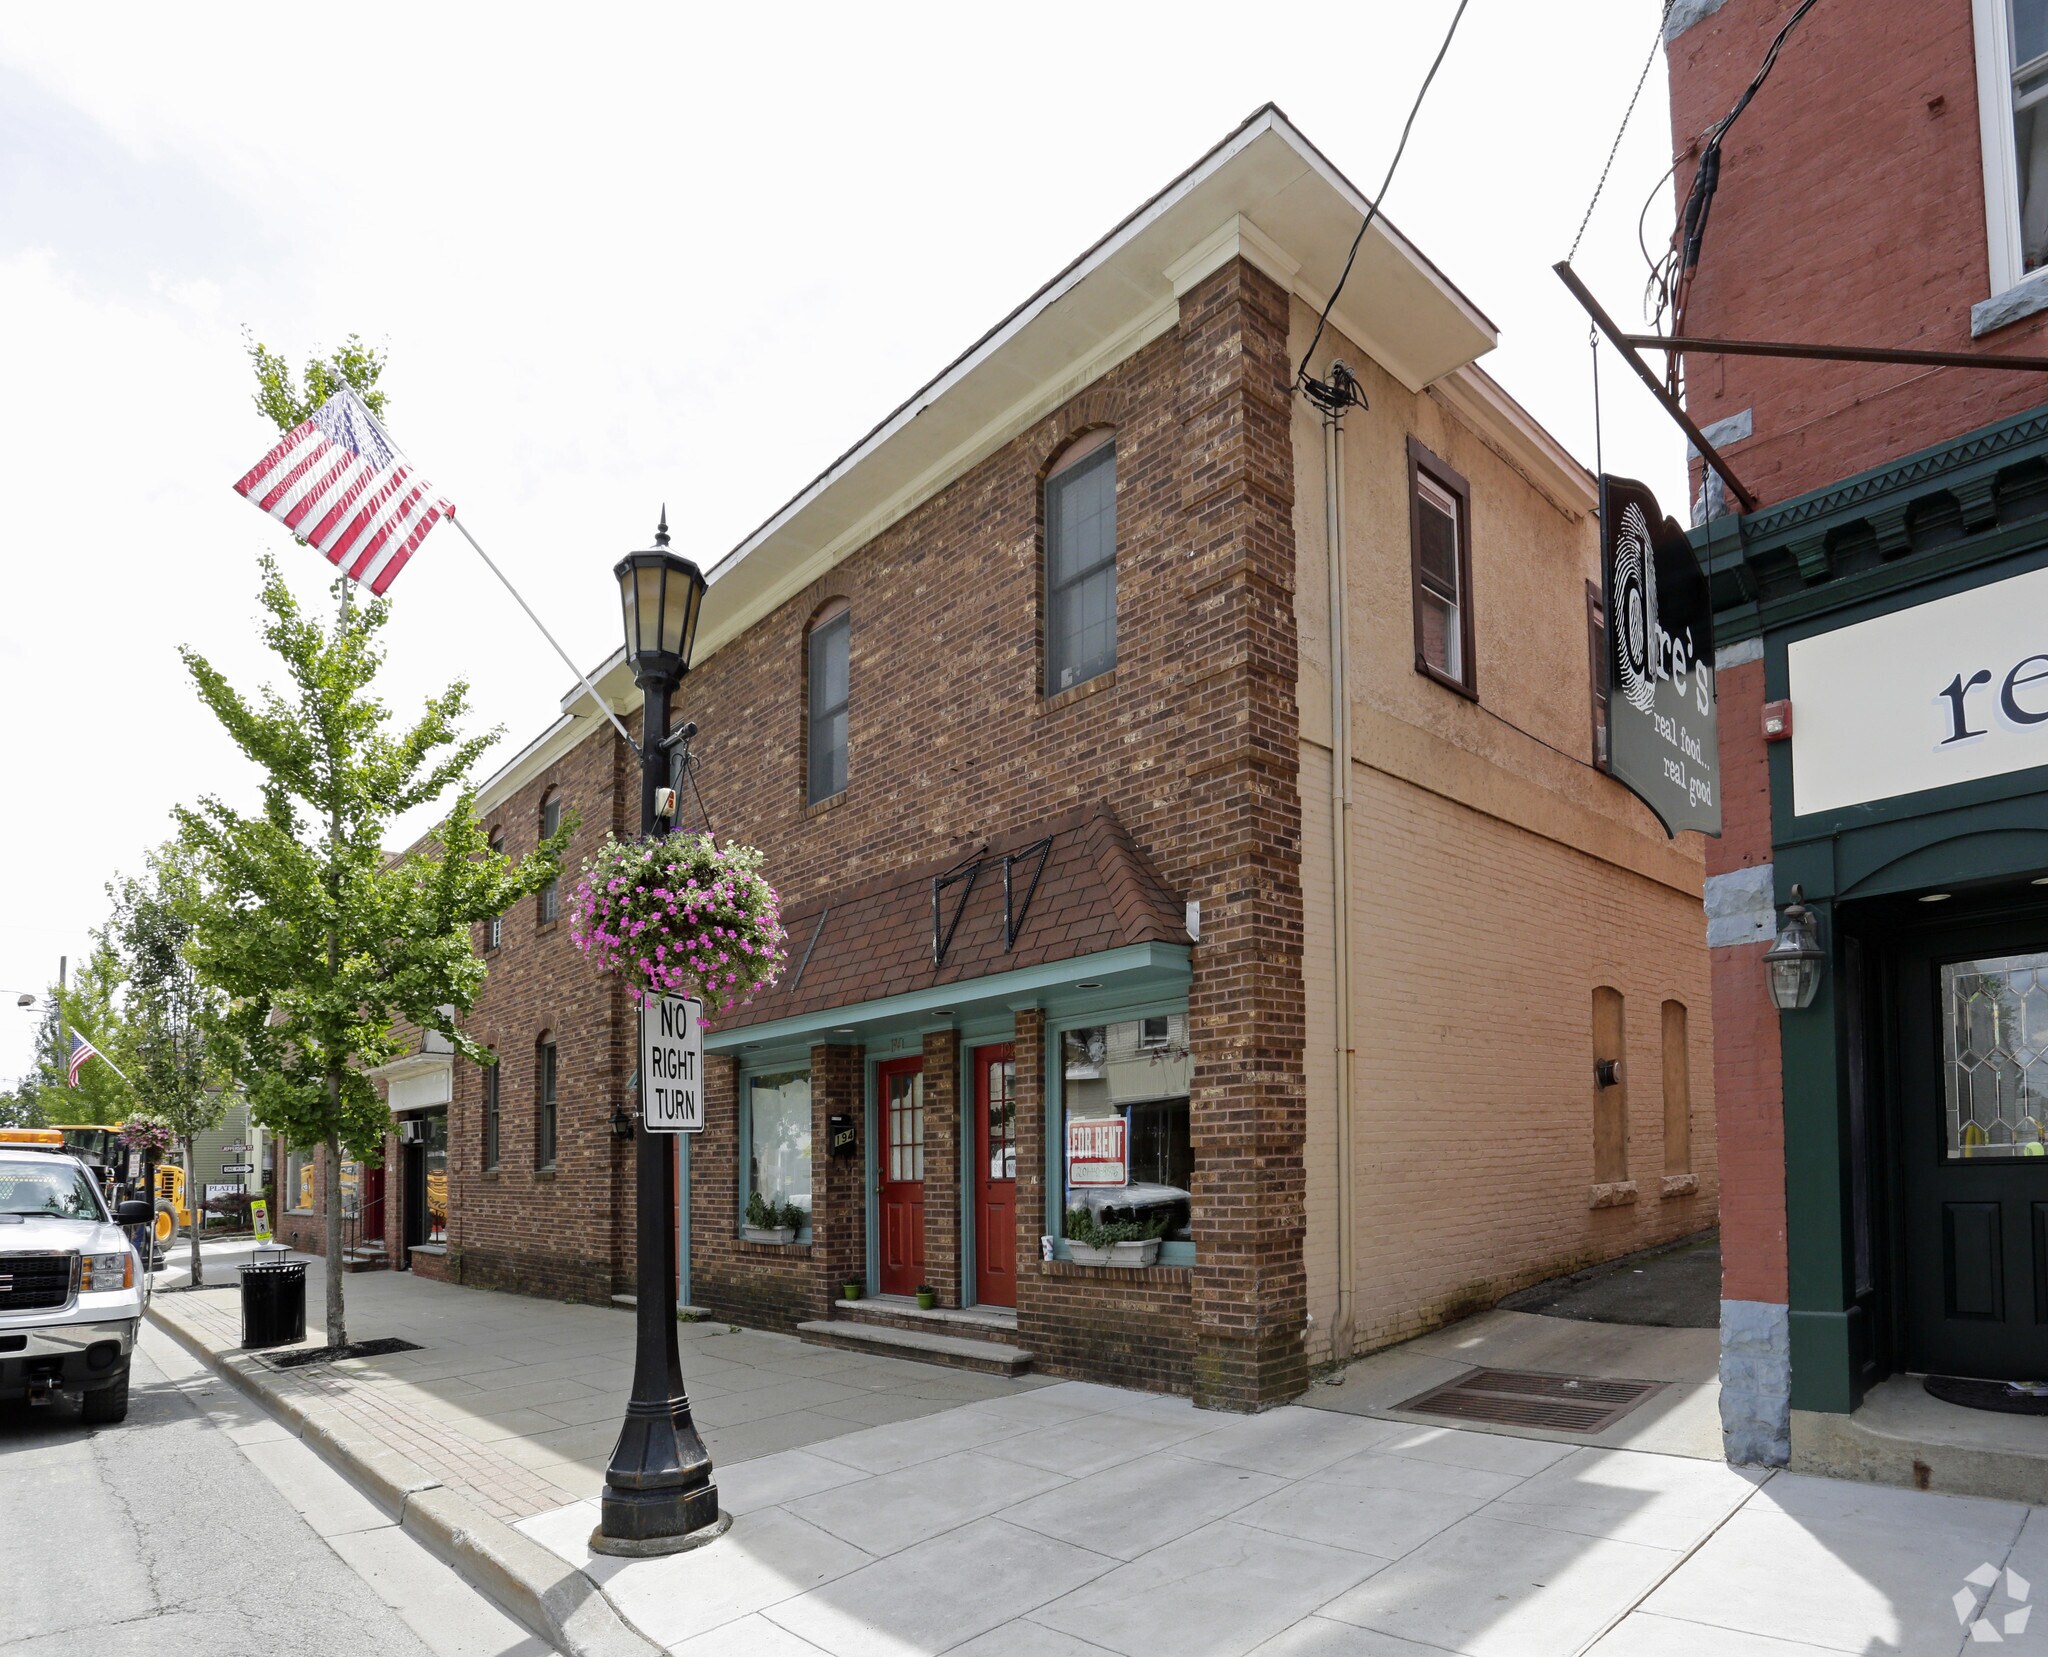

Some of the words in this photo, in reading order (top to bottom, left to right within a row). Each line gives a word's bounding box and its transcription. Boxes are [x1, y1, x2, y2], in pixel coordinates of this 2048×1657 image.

[1938, 654, 2048, 745] re
[1654, 712, 1677, 746] real
[1681, 726, 1710, 771] food...
[1664, 757, 1687, 789] real
[1690, 777, 1712, 807] good
[661, 1000, 687, 1040] NO
[652, 1046, 695, 1081] RIGHT
[655, 1088, 695, 1120] TURN
[836, 1129, 853, 1145] 194
[1072, 1127, 1092, 1159] FOR
[1095, 1125, 1122, 1158] RENT
